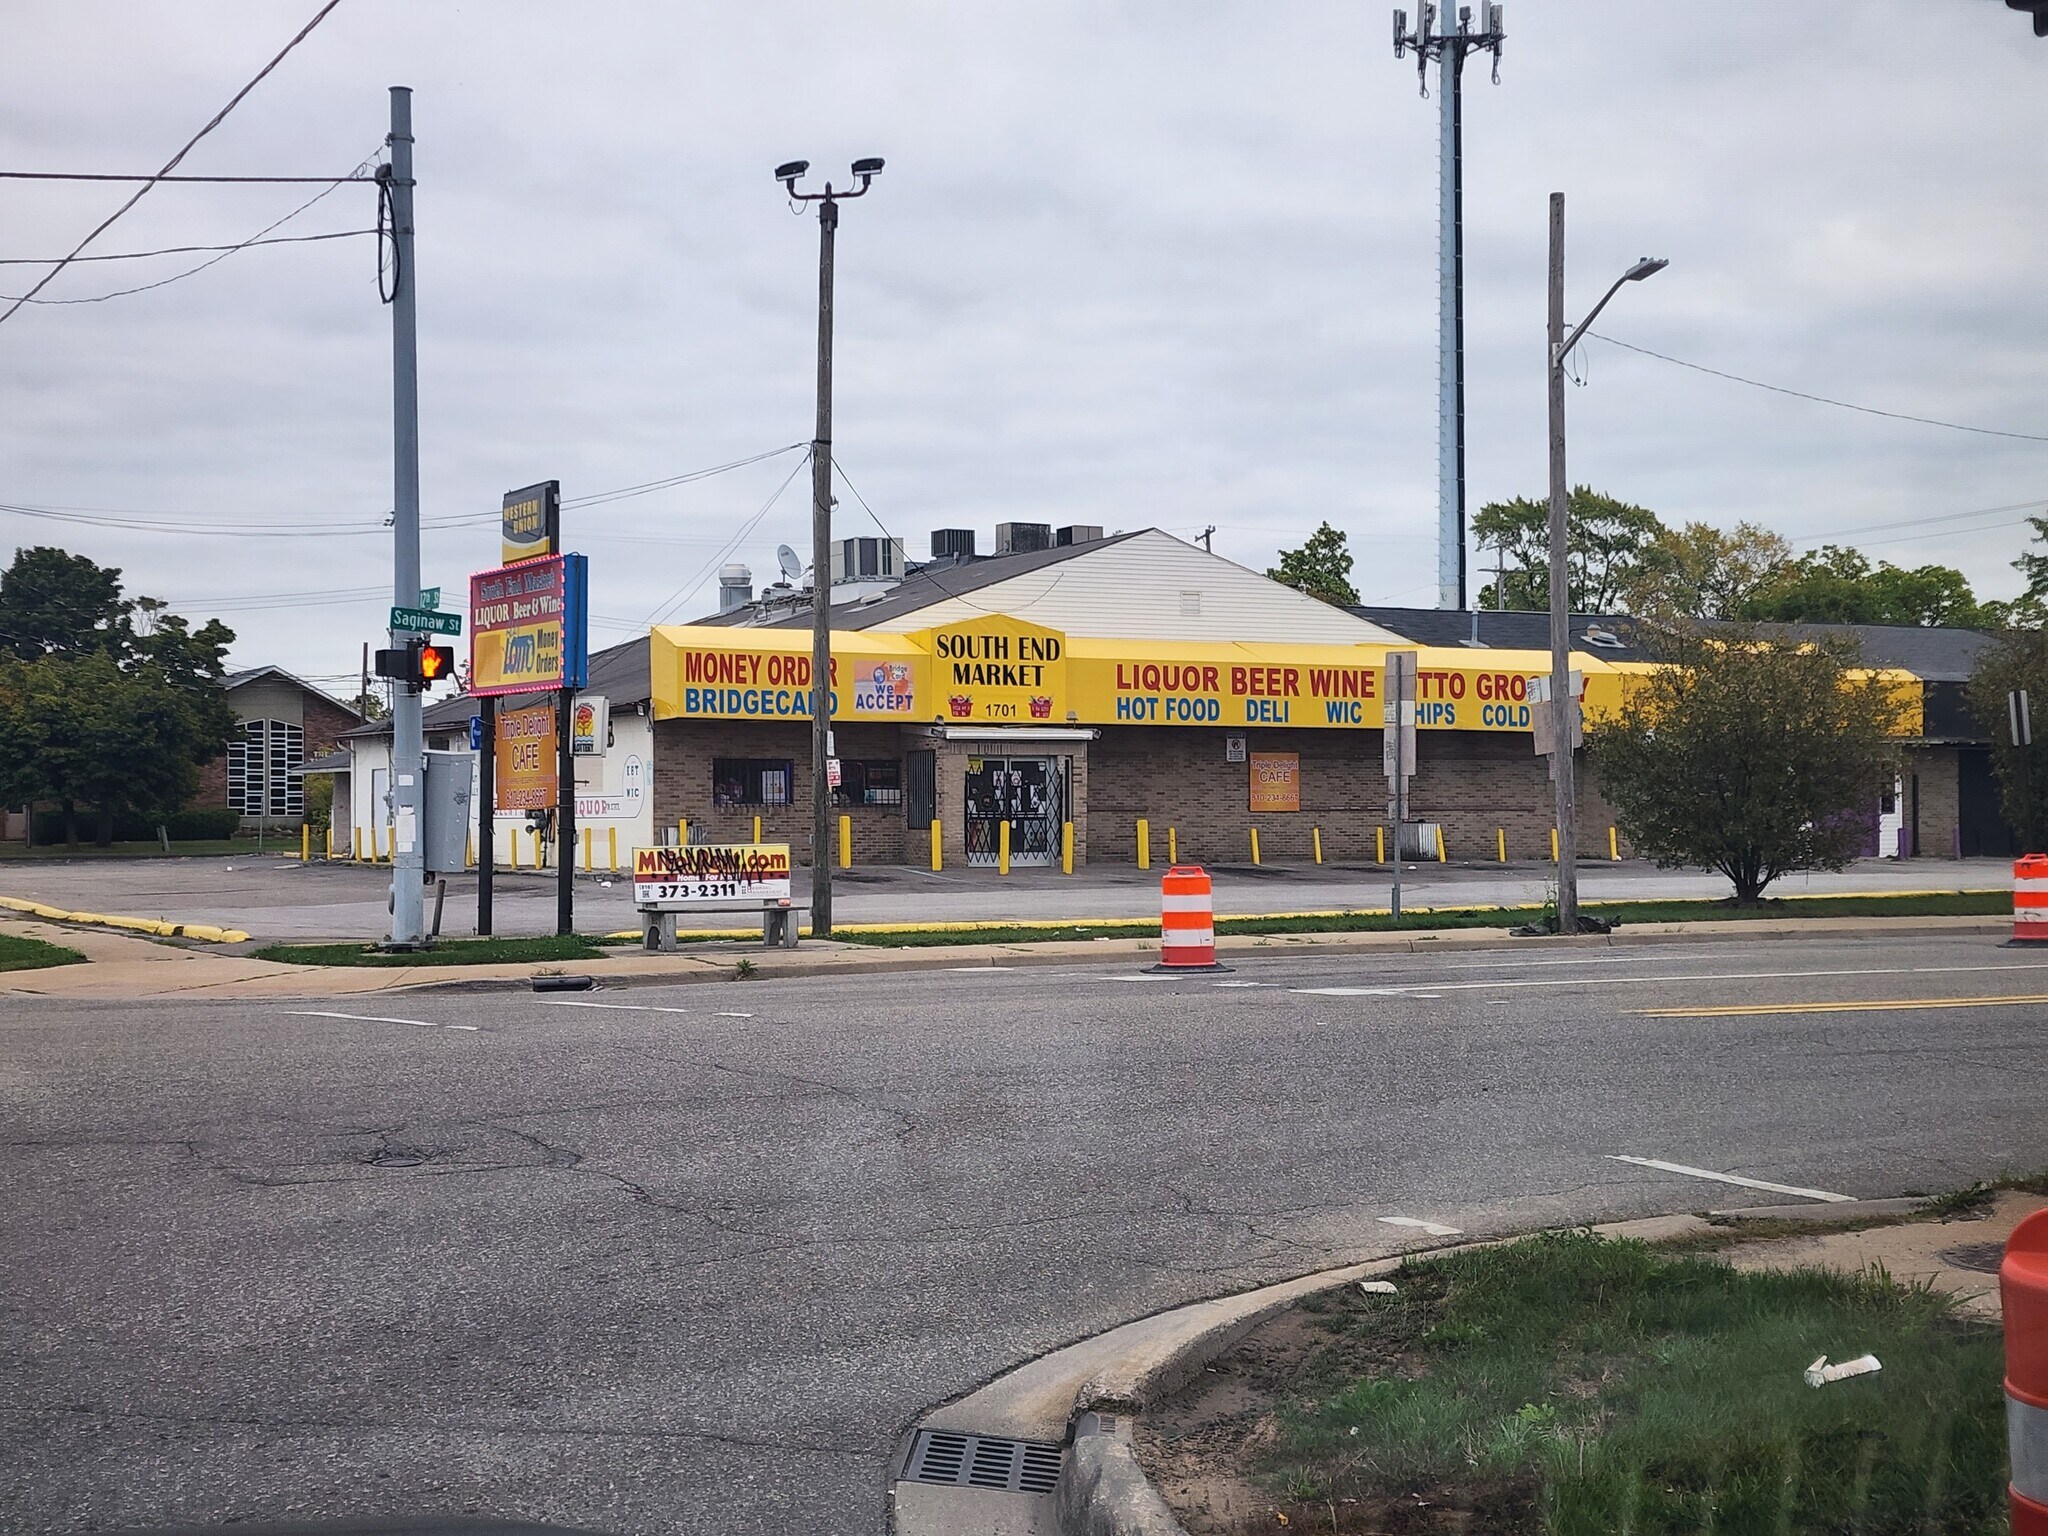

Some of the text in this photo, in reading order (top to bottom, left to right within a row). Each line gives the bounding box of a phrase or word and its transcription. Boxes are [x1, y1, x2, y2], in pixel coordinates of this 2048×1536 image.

[504, 499, 538, 522] WESTERN
[513, 514, 538, 534] UNION
[480, 568, 555, 601] South End Market
[394, 610, 459, 631] Saginaw St
[474, 604, 509, 629] LIQUOR
[513, 602, 531, 619] Beer
[540, 596, 561, 614] Wine
[537, 629, 559, 650] Money
[936, 634, 1060, 662] SOUTH END
[536, 653, 559, 673] Orders
[685, 652, 838, 687] MONEY ORDR
[889, 665, 908, 674] Bridge
[891, 672, 905, 680] Card
[952, 663, 1045, 688] MARKET
[1117, 664, 1220, 694] LIQUOR
[1231, 666, 1300, 697] BEER
[1308, 668, 1375, 699] WINE
[1476, 673, 1590, 702] GROY
[856, 693, 913, 711] ACCEPT
[985, 704, 1016, 717] 1701
[1118, 697, 1158, 720] HOT
[1166, 698, 1220, 722] FOOD
[1247, 699, 1289, 722] DELI
[1326, 700, 1363, 724] WIC
[1416, 702, 1456, 726] HIPS
[1482, 704, 1530, 728] COLD
[500, 711, 550, 744] Triple Delight
[511, 742, 539, 772] CAFE
[1252, 760, 1298, 771] Triple Delight
[1259, 771, 1291, 783] CAFE
[626, 788, 639, 797] WIC
[658, 883, 736, 898] 373-2311
